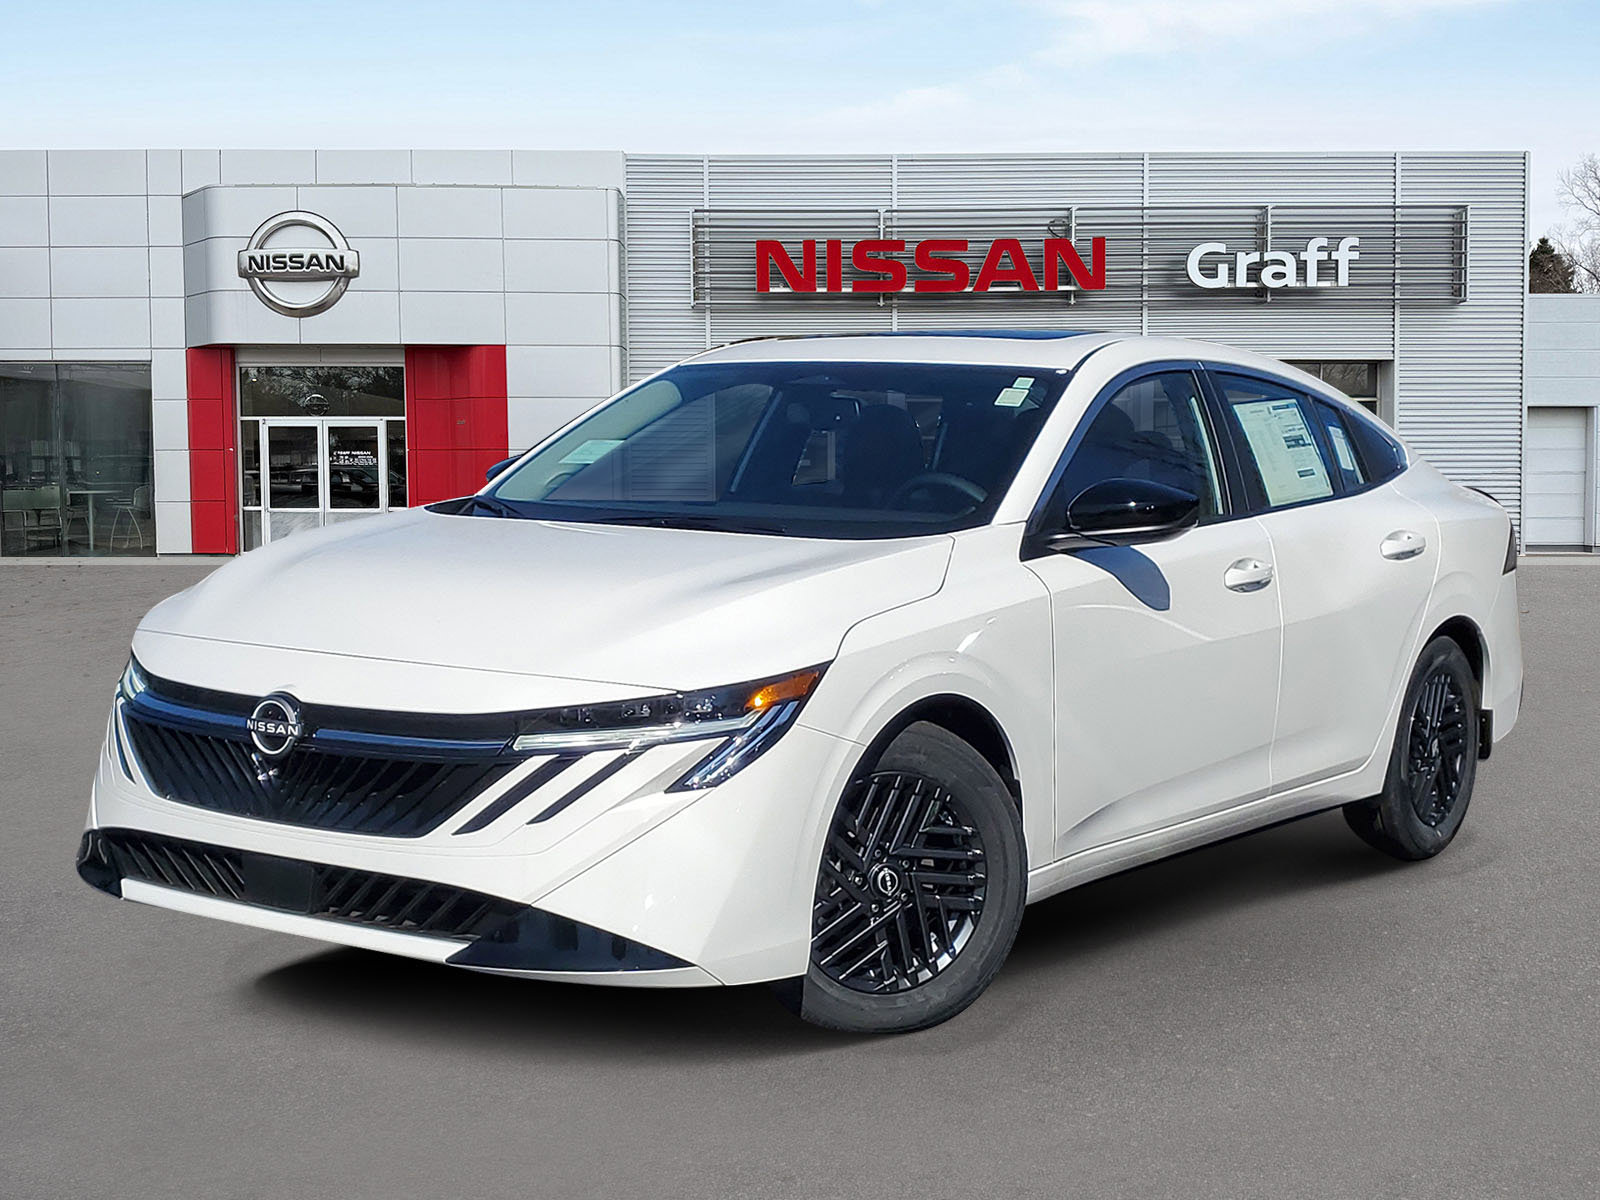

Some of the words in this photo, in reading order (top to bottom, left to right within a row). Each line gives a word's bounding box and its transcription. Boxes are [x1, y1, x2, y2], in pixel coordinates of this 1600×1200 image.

[247, 253, 345, 272] NISSAN
[755, 237, 1106, 293] NISSAN
[1186, 237, 1360, 289] Graff
[246, 719, 299, 735] NISSAN
